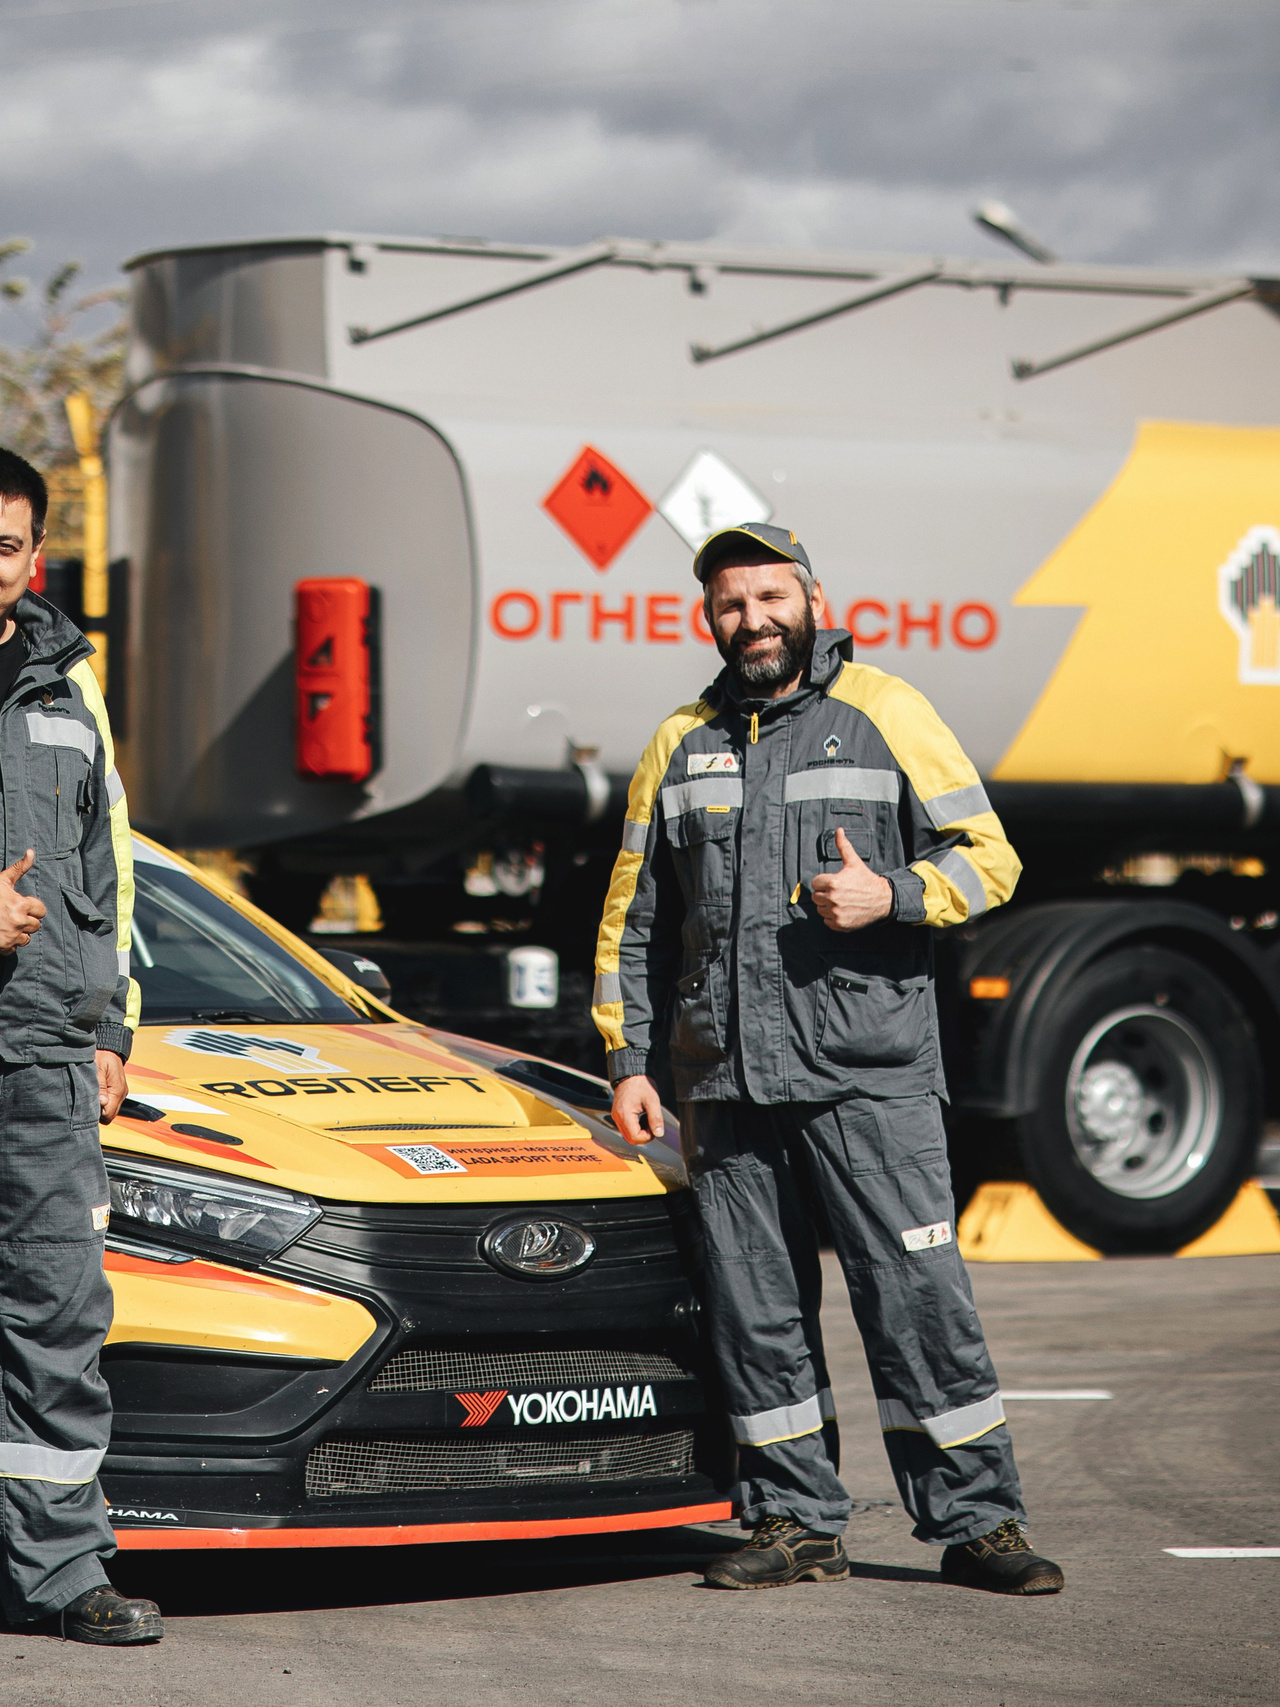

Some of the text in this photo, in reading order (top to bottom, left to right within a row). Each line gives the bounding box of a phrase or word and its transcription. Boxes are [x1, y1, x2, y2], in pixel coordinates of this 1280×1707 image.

[199, 1076, 486, 1099] ROSNEFT
[460, 1153, 603, 1165] LADA SPORT STORE
[506, 1384, 658, 1426] YOKOHAMA
[105, 1508, 179, 1521] HAMA
